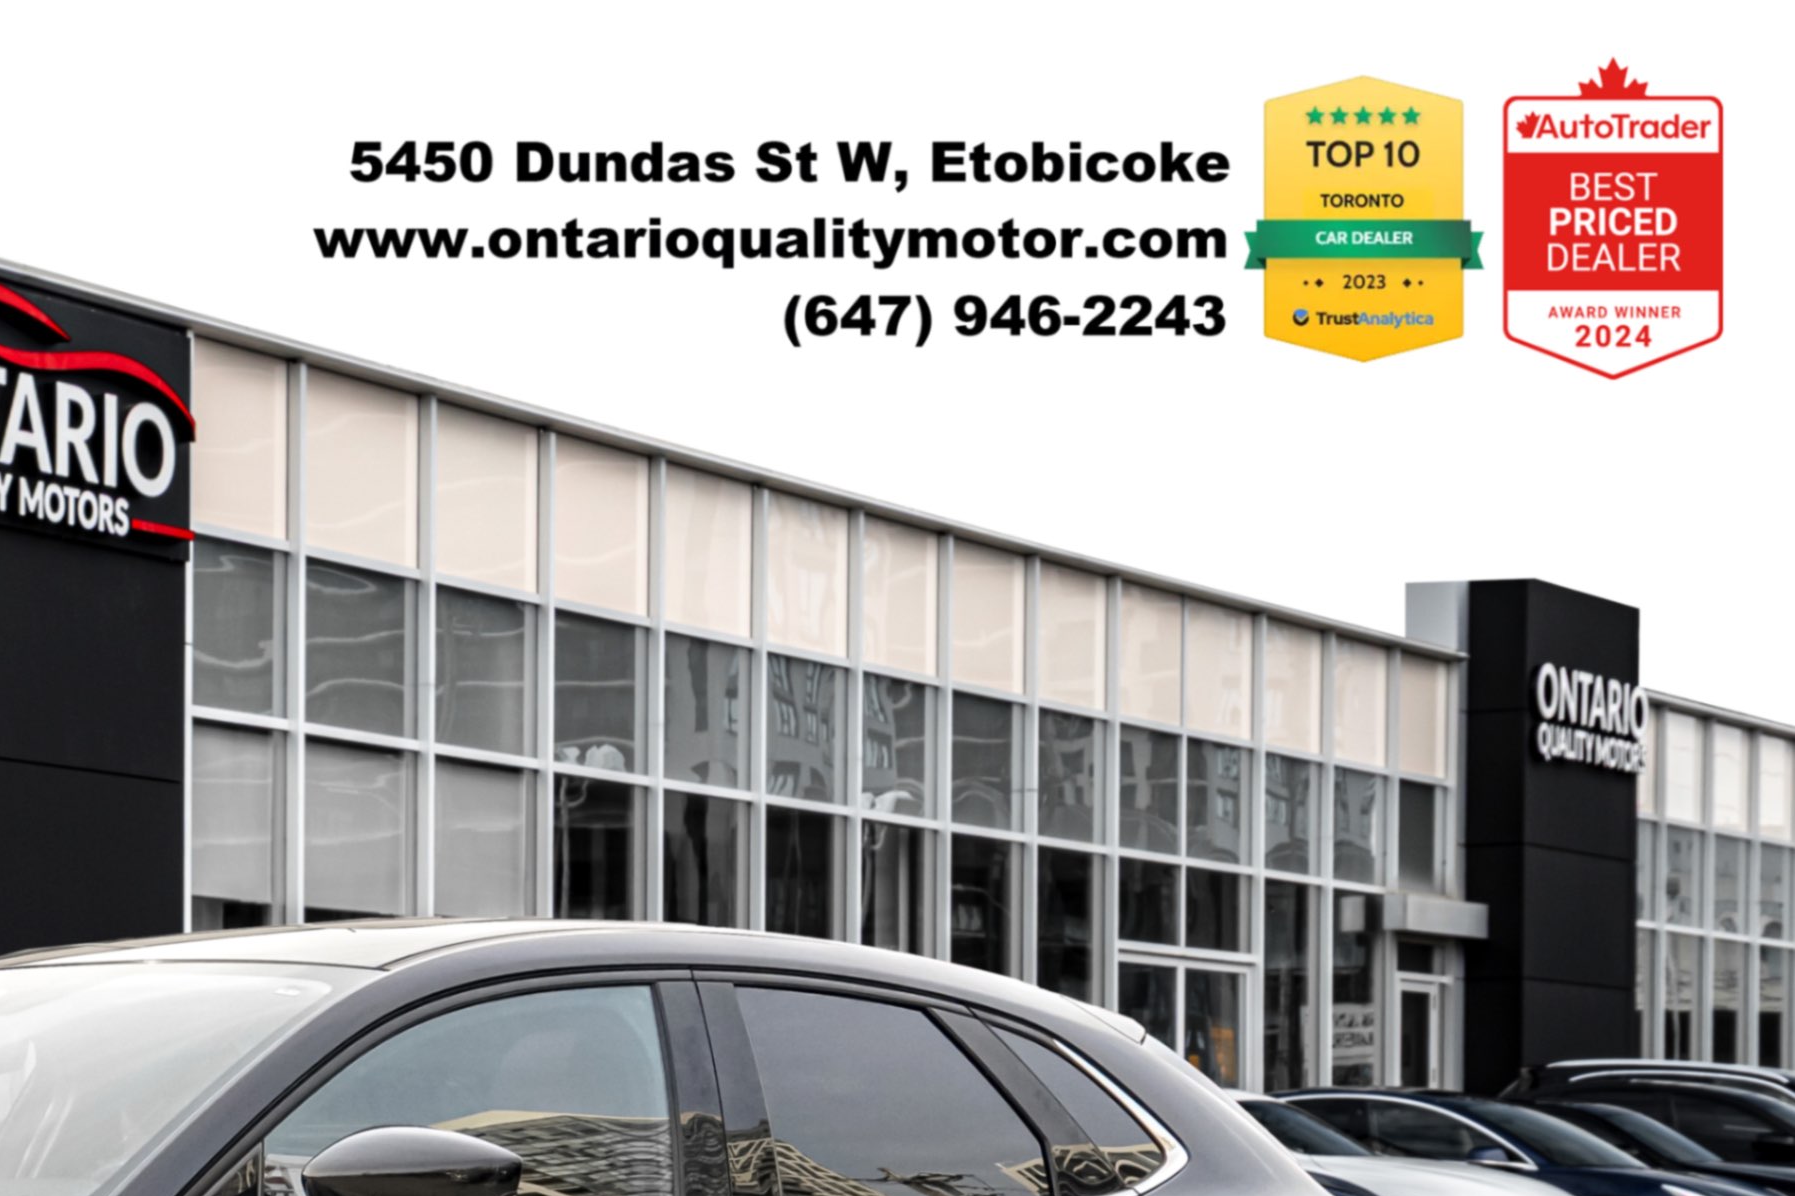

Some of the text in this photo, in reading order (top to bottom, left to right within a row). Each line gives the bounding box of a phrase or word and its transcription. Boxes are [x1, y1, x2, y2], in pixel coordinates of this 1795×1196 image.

[18, 476, 130, 537] MOTORS
[1537, 662, 1649, 739] ONTARIO
[1537, 722, 1594, 763] QUALITY
